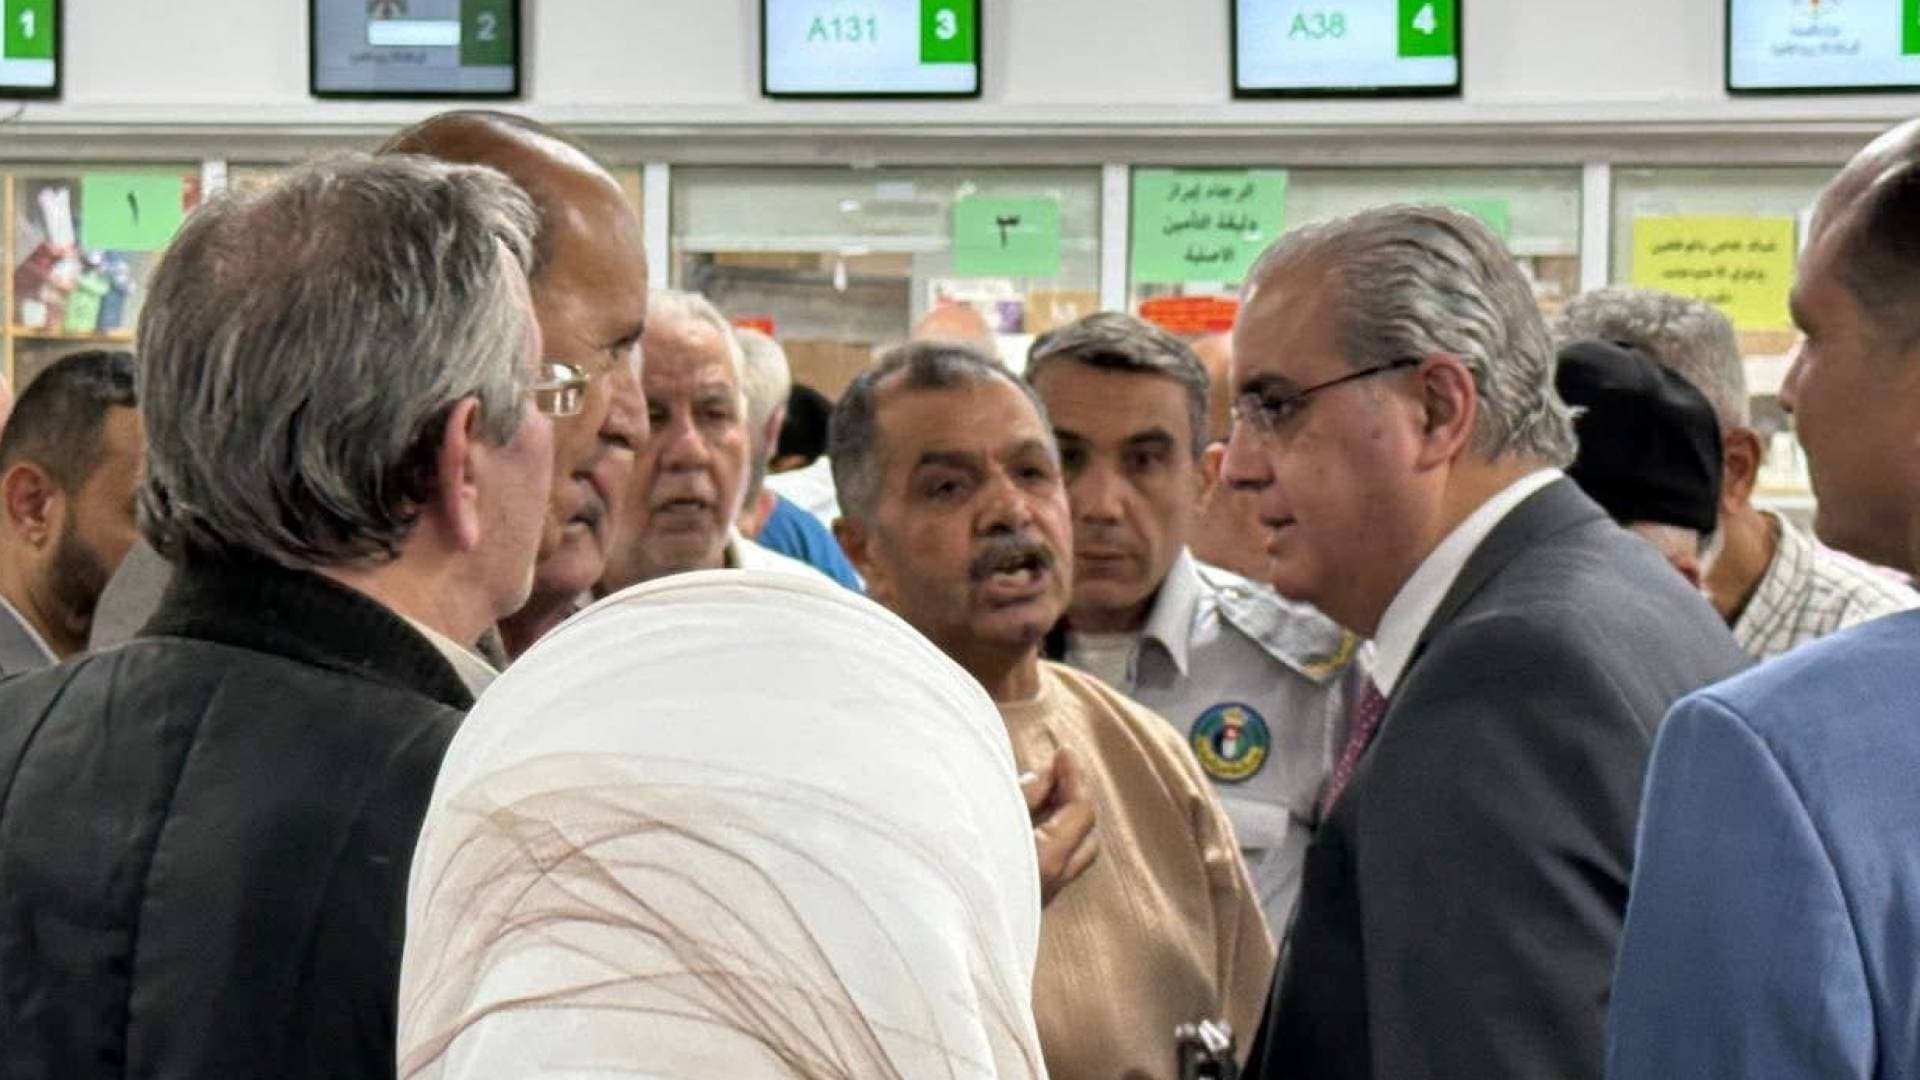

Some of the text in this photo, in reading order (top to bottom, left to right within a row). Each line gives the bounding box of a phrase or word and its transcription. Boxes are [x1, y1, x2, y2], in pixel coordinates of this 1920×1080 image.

[19, 9, 35, 39] 1
[476, 14, 497, 41] 2
[807, 16, 877, 43] A131
[935, 9, 957, 40] 3
[1288, 13, 1346, 39] A38
[1412, 3, 1437, 35] 4
